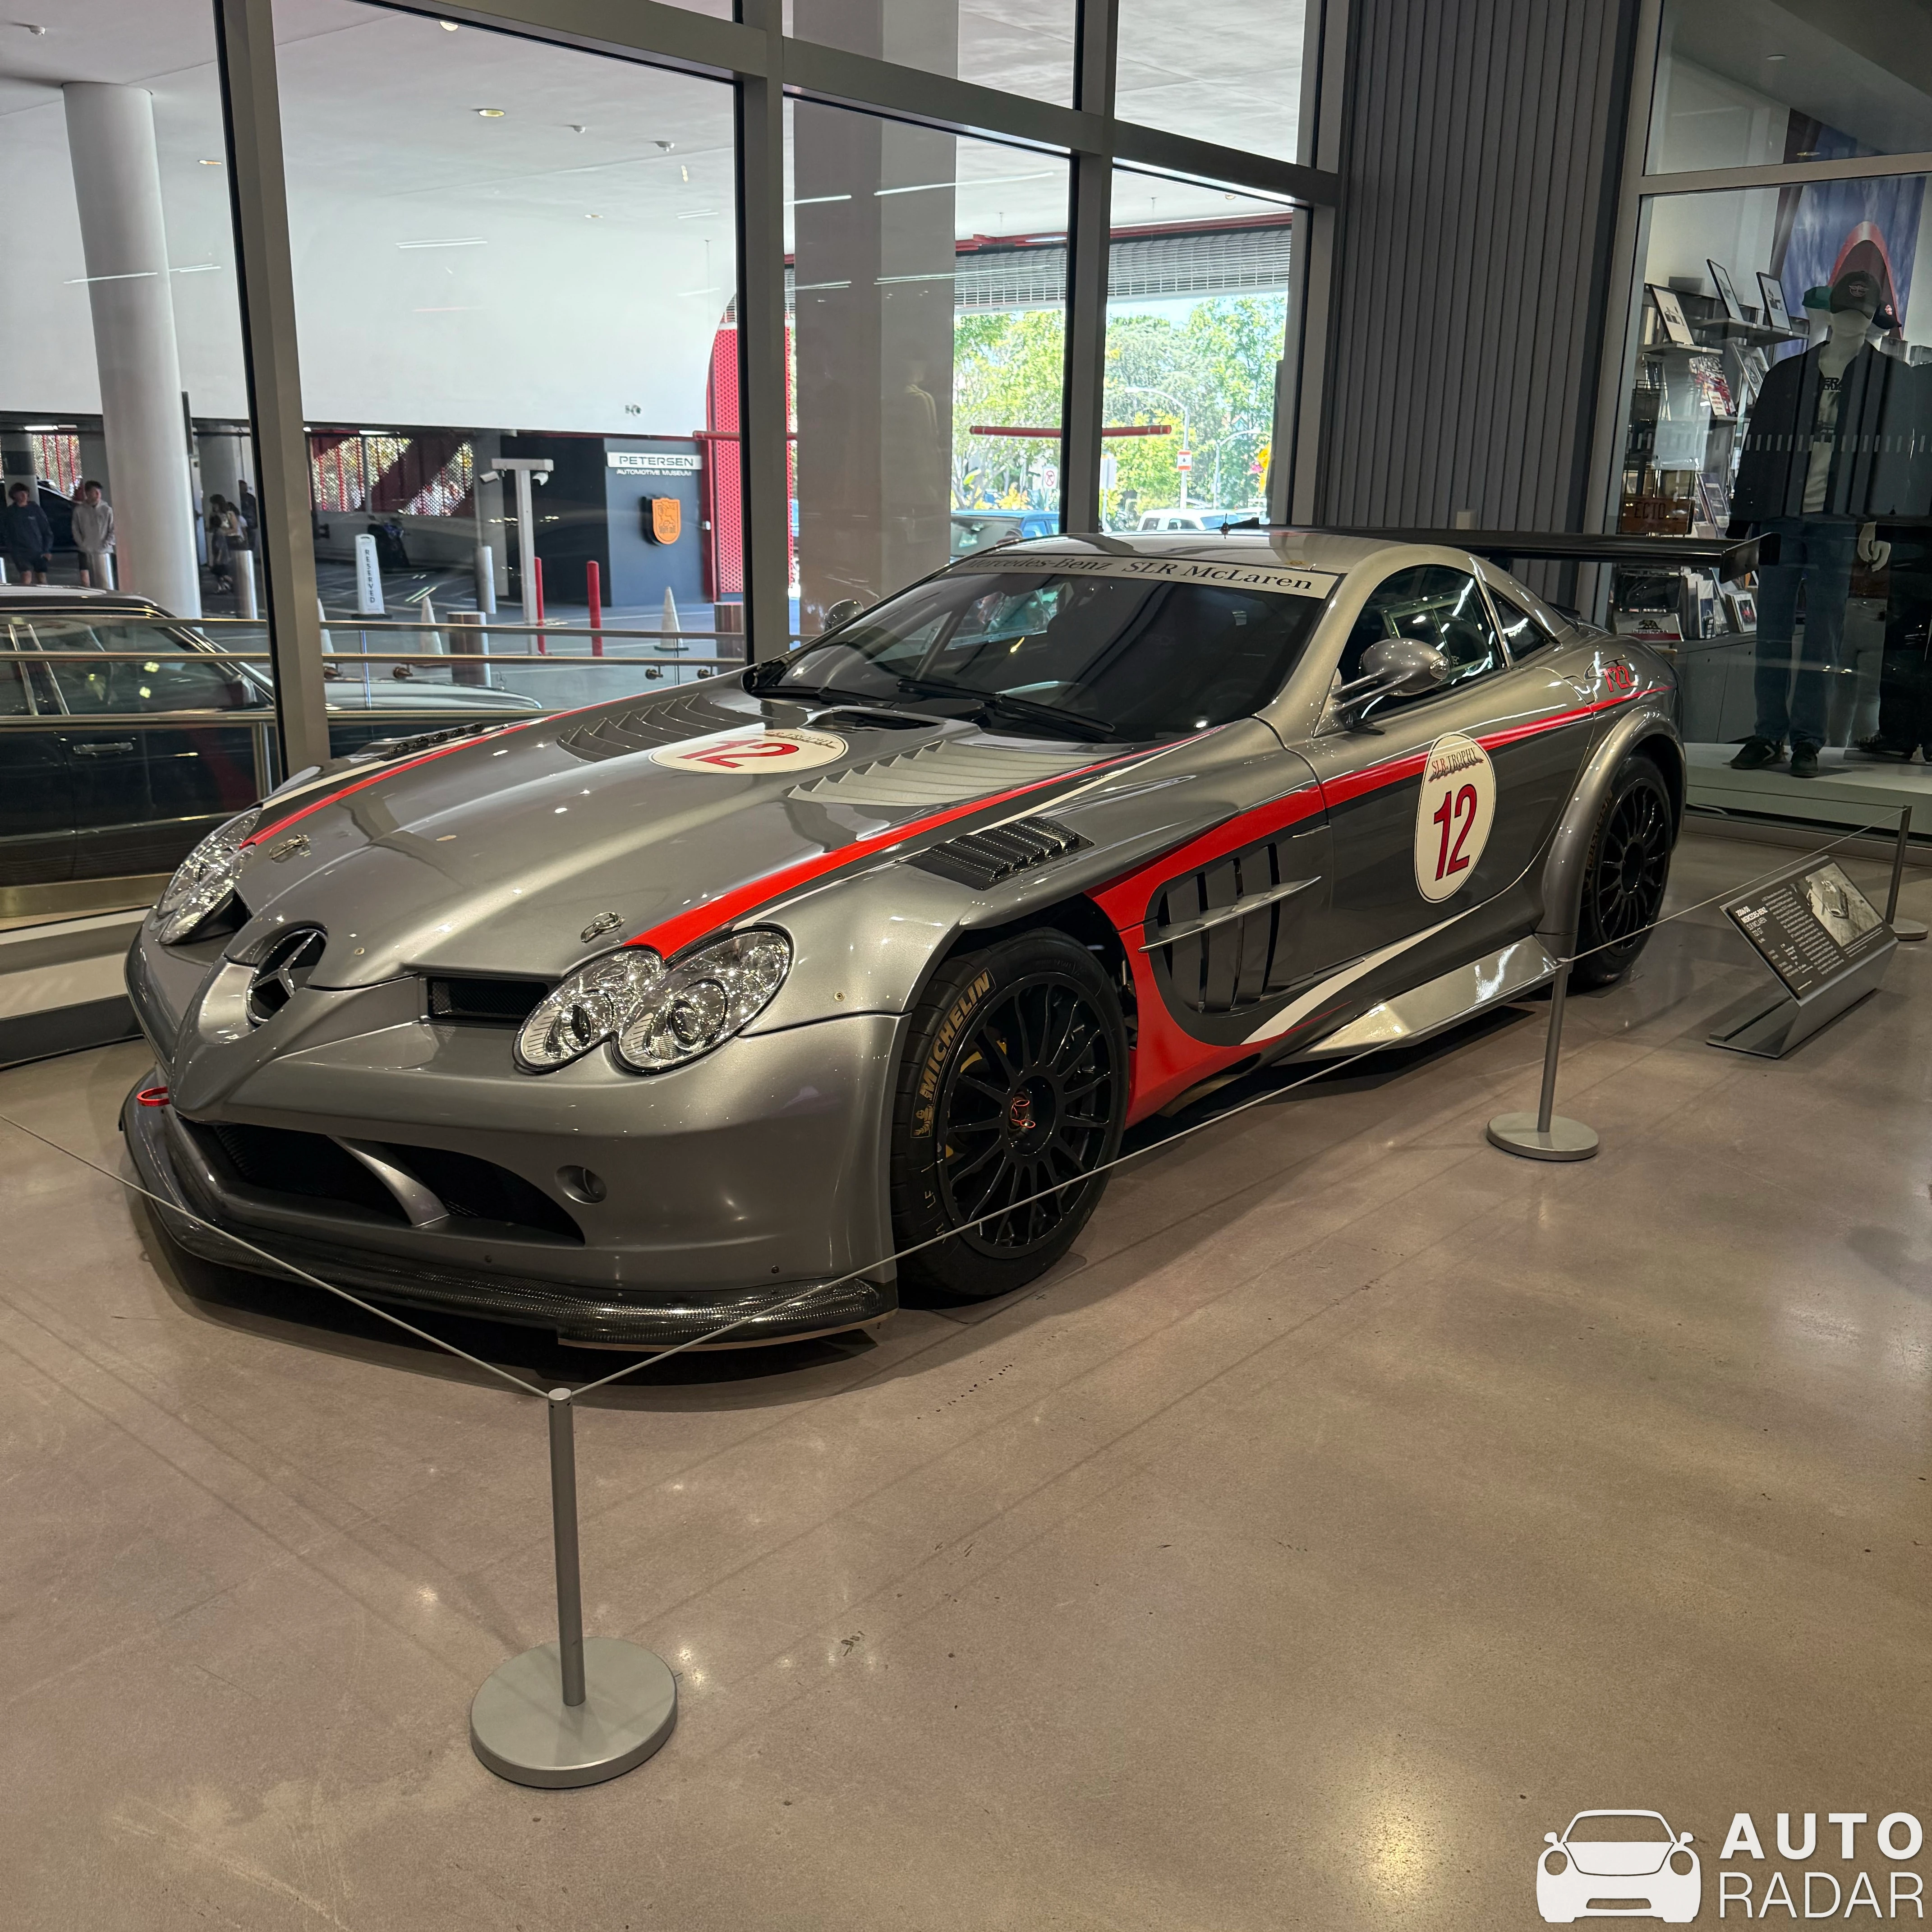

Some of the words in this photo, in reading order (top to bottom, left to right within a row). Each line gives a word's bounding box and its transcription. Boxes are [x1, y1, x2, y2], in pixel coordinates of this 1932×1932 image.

[619, 456, 694, 466] PETERSEN
[365, 549, 375, 603] RESERVED
[967, 557, 1114, 571] Mercedes-Benz
[1121, 561, 1179, 575] SLR
[1180, 565, 1312, 590] McLaren
[676, 739, 800, 768] 12
[1434, 783, 1477, 881] 12
[919, 971, 990, 1101] MICHELIN
